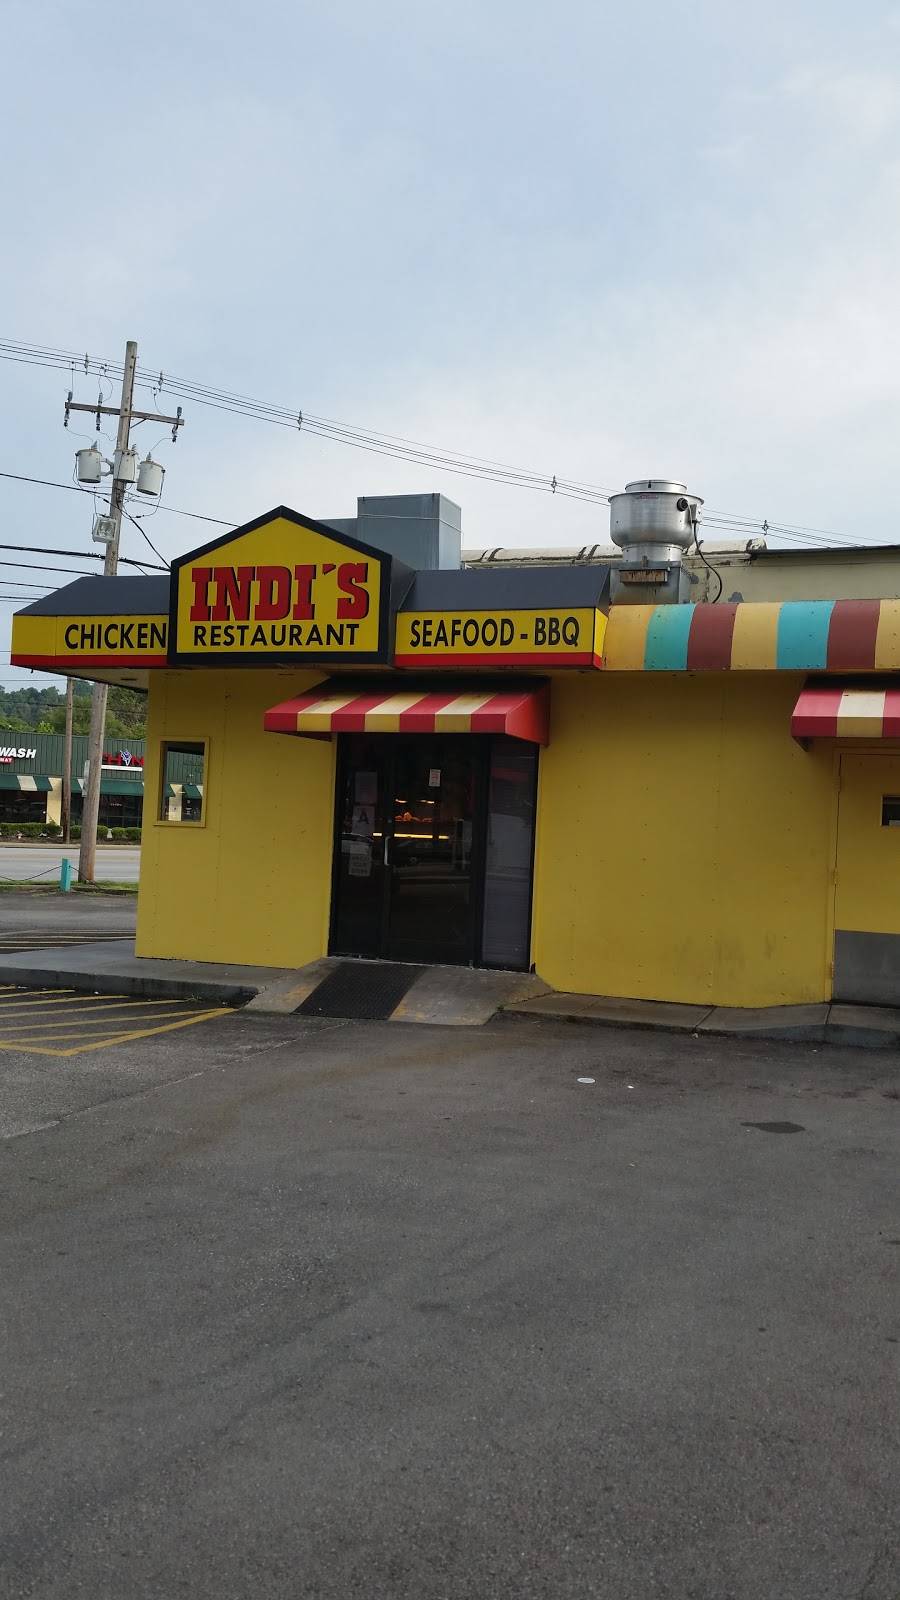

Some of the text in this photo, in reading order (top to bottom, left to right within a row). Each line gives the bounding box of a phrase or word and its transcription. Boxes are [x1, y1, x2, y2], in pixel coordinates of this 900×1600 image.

[190, 563, 369, 621] INDI'S
[65, 623, 167, 649] CHICKEN
[193, 624, 359, 646] RESTAURANT
[410, 618, 514, 647] SEAFOOD
[534, 616, 580, 647] BBQ
[0, 747, 36, 758] WASH
[358, 808, 370, 825] A
